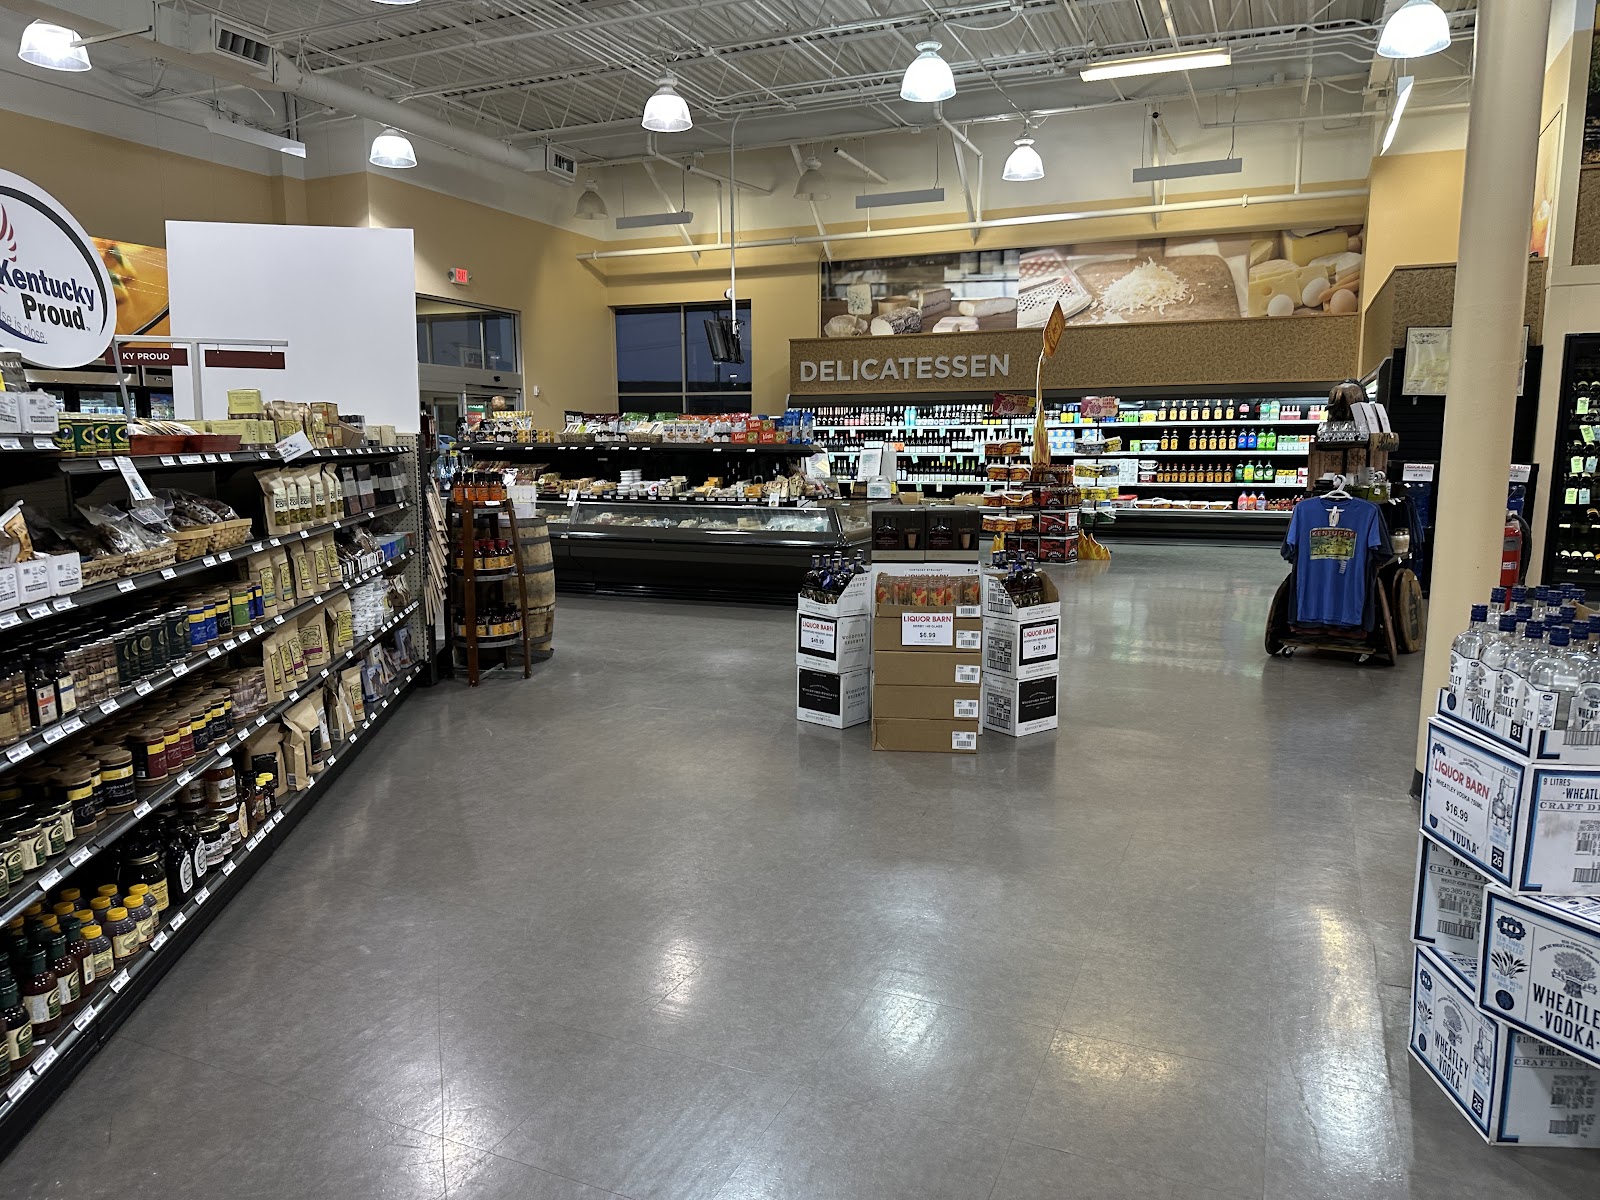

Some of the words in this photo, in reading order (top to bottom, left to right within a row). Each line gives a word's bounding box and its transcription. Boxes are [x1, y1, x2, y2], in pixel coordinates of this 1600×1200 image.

[0, 259, 94, 311] Kentucky
[21, 293, 85, 331] Proud
[138, 353, 170, 361] PROUD
[800, 354, 1009, 382] DELICATESSEN
[803, 621, 820, 630] LIQUOR
[820, 623, 834, 632] BARN
[1024, 630, 1043, 638] LIQUOR
[1043, 627, 1056, 635] BARN
[1471, 701, 1496, 730] VODKA
[1511, 724, 1522, 738] 81
[1434, 758, 1464, 784] LIQUOR
[1465, 777, 1490, 800] BARN
[1550, 778, 1571, 786] LITRES
[1436, 778, 1456, 794] WHEATLEY
[1456, 790, 1471, 802] VODKA
[1445, 800, 1469, 823] $16.99
[1539, 801, 1583, 811] CRAFT
[1492, 853, 1503, 868] 26
[1429, 864, 1470, 879] CRAFT
[1544, 1009, 1595, 1050] VODKA
[1434, 1029, 1469, 1080] WHEATLEY
[1514, 1059, 1557, 1067] CRAFT
[1438, 1054, 1461, 1093] VODKA
[1472, 1102, 1482, 1114] 26
